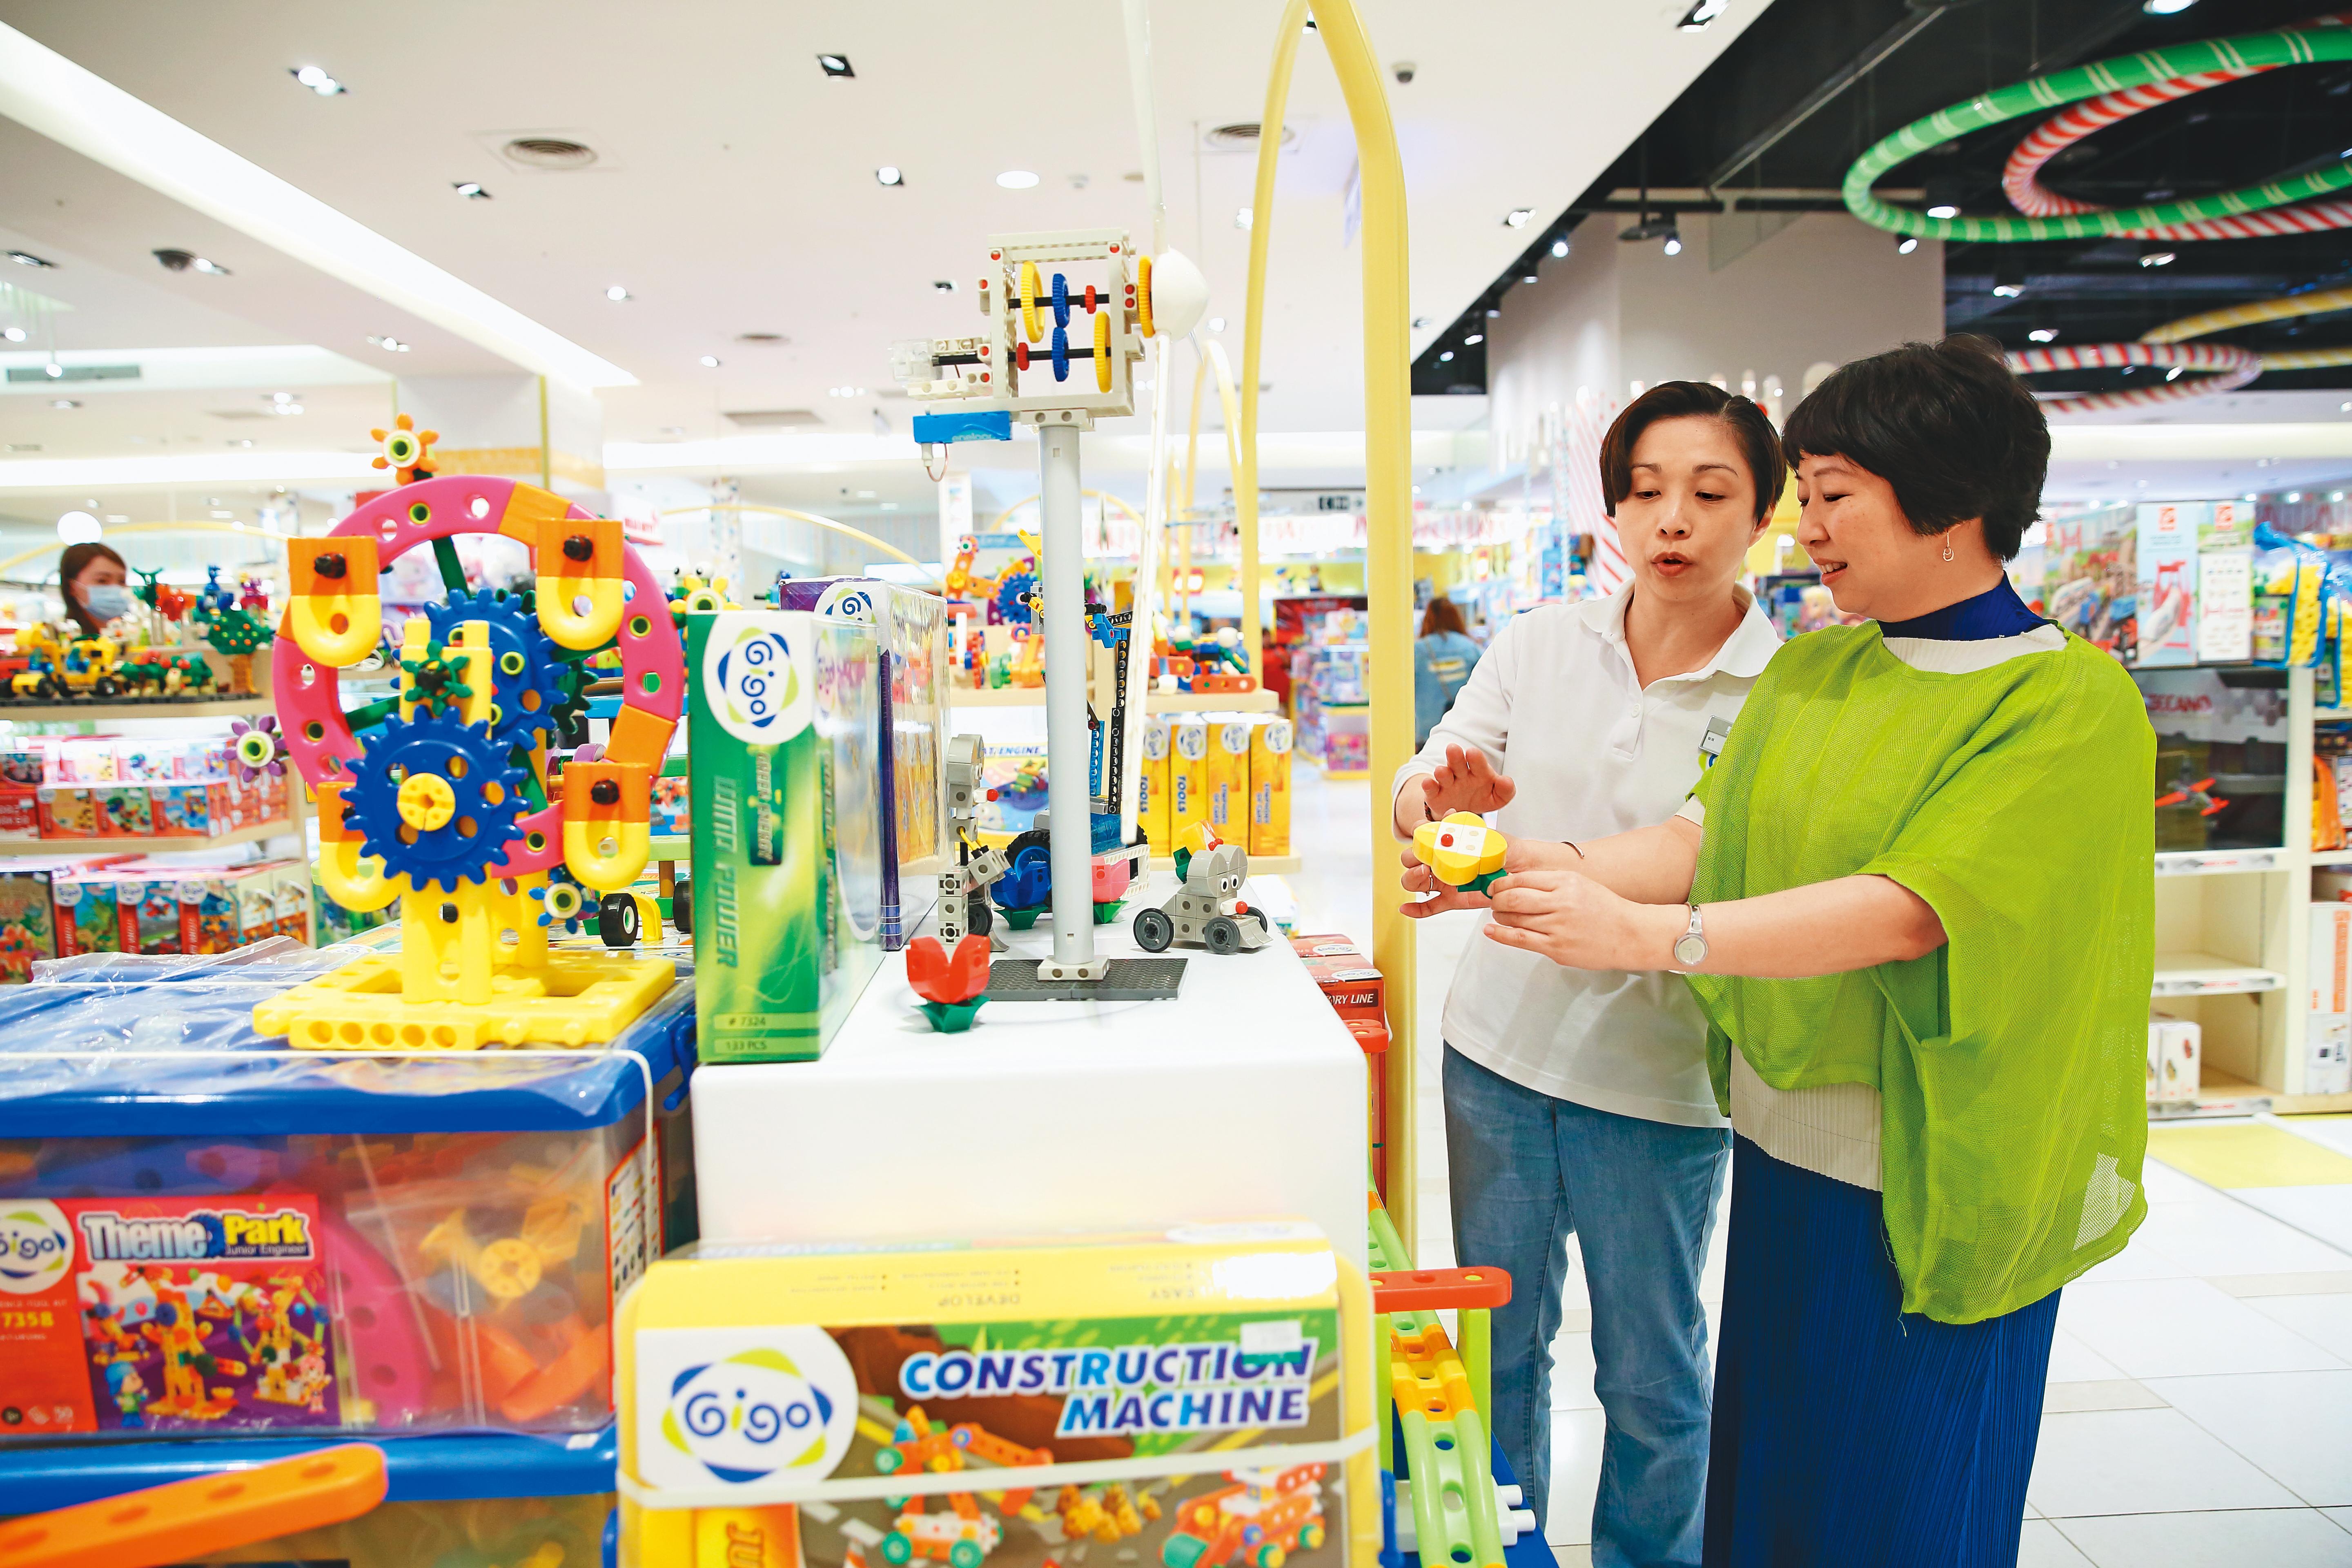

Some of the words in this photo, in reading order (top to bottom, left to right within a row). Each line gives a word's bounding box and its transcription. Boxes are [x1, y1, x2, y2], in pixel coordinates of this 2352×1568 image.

[740, 640, 775, 717] Gigo
[756, 752, 772, 800] GREEN
[1177, 776, 1187, 813] TOOLS
[713, 775, 737, 853] WIND
[756, 803, 773, 862] ENERGY
[715, 861, 739, 969] POWER
[1350, 993, 1374, 1004] LINE
[747, 1040, 767, 1050] PCS
[84, 1214, 207, 1259] Theme
[223, 1213, 305, 1245] Park
[2, 1311, 54, 1328] 7358
[937, 1293, 1021, 1308] DEVELOP
[684, 1388, 811, 1443] Gigo
[1062, 1390, 1305, 1432] MACHINE
